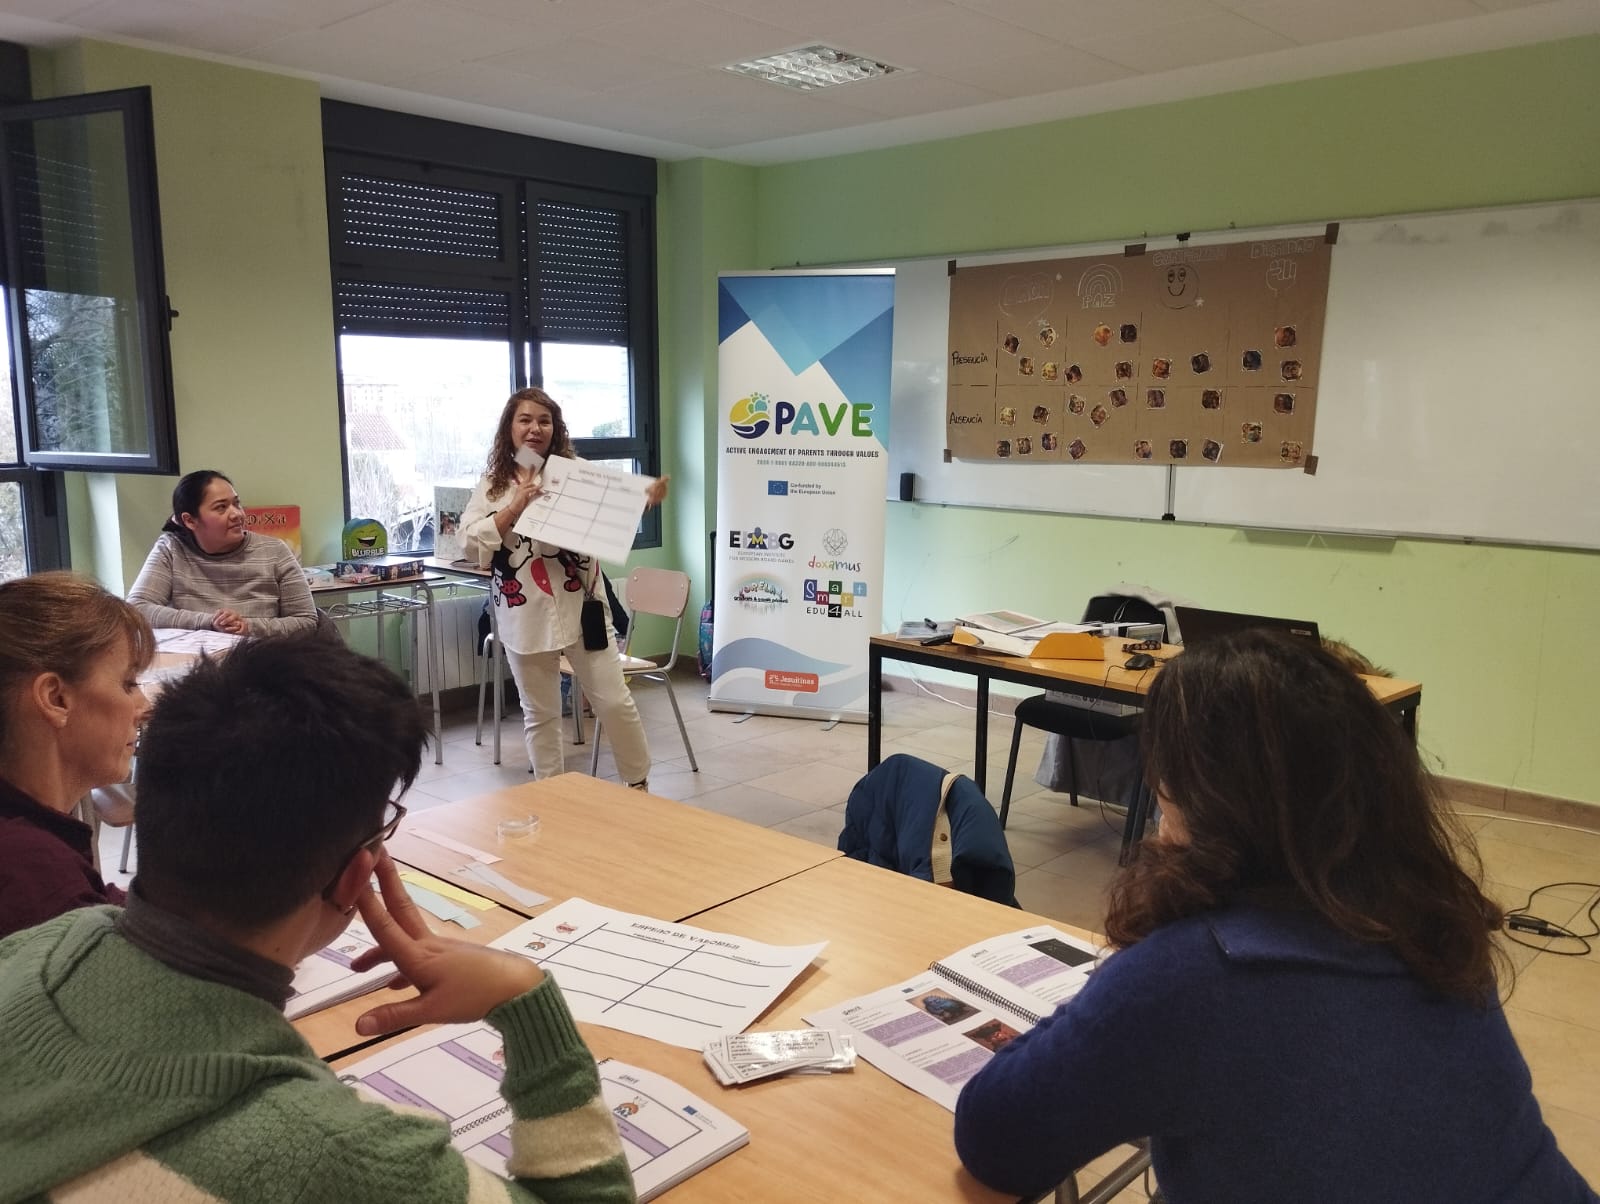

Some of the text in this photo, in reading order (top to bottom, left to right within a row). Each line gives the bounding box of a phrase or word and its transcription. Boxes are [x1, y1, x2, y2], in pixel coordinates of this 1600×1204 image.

[775, 401, 874, 438] PAVE
[725, 447, 879, 458] ACTIVE ENGAGEMENT OF PARENTS THROUGH VALUES
[808, 555, 862, 573] doxamus
